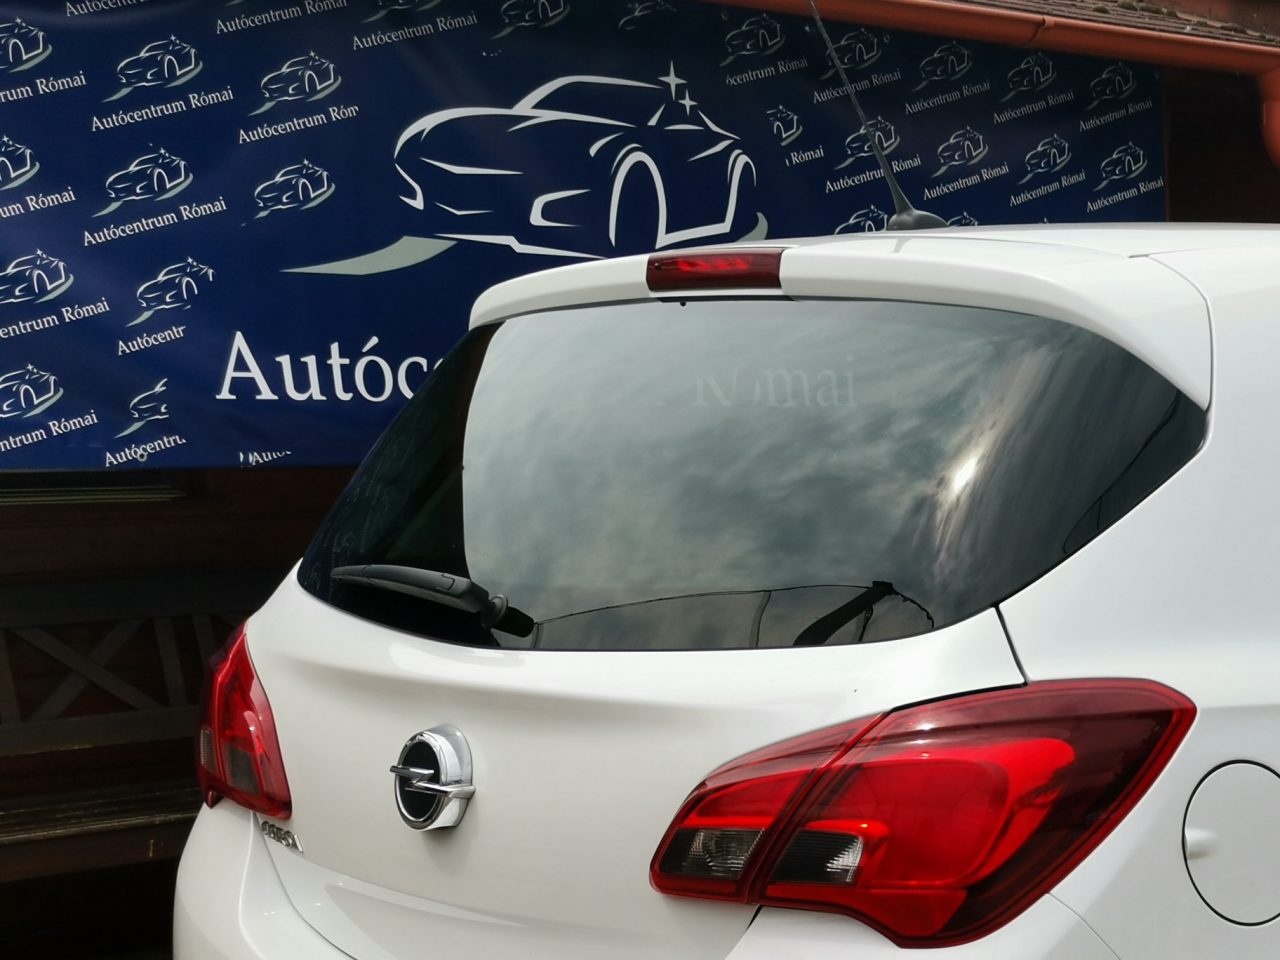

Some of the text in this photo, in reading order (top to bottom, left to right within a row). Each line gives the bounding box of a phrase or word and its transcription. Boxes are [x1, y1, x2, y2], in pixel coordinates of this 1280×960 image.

[216, 5, 301, 34] Autócentrum
[352, 11, 478, 50] Autócentrum Római
[36, 71, 86, 94] Római
[813, 79, 870, 104] Autócenrum
[91, 86, 234, 131] Autócentrum Római
[905, 91, 961, 115] Autócentrum
[993, 98, 1047, 125] Autócentrum
[238, 112, 327, 144] Autócentrum
[790, 145, 824, 165] Római
[825, 154, 922, 194] Autócentru Római
[923, 162, 1009, 200] Autócentrum Római
[1009, 169, 1086, 207] Autócentrum Római
[25, 186, 76, 212] Római
[1086, 186, 1138, 213] Autócentrum
[83, 196, 228, 246] Autócentrum Római
[0, 297, 110, 338] entrum Római
[215, 331, 444, 402] Autóc
[48, 409, 98, 436] Római
